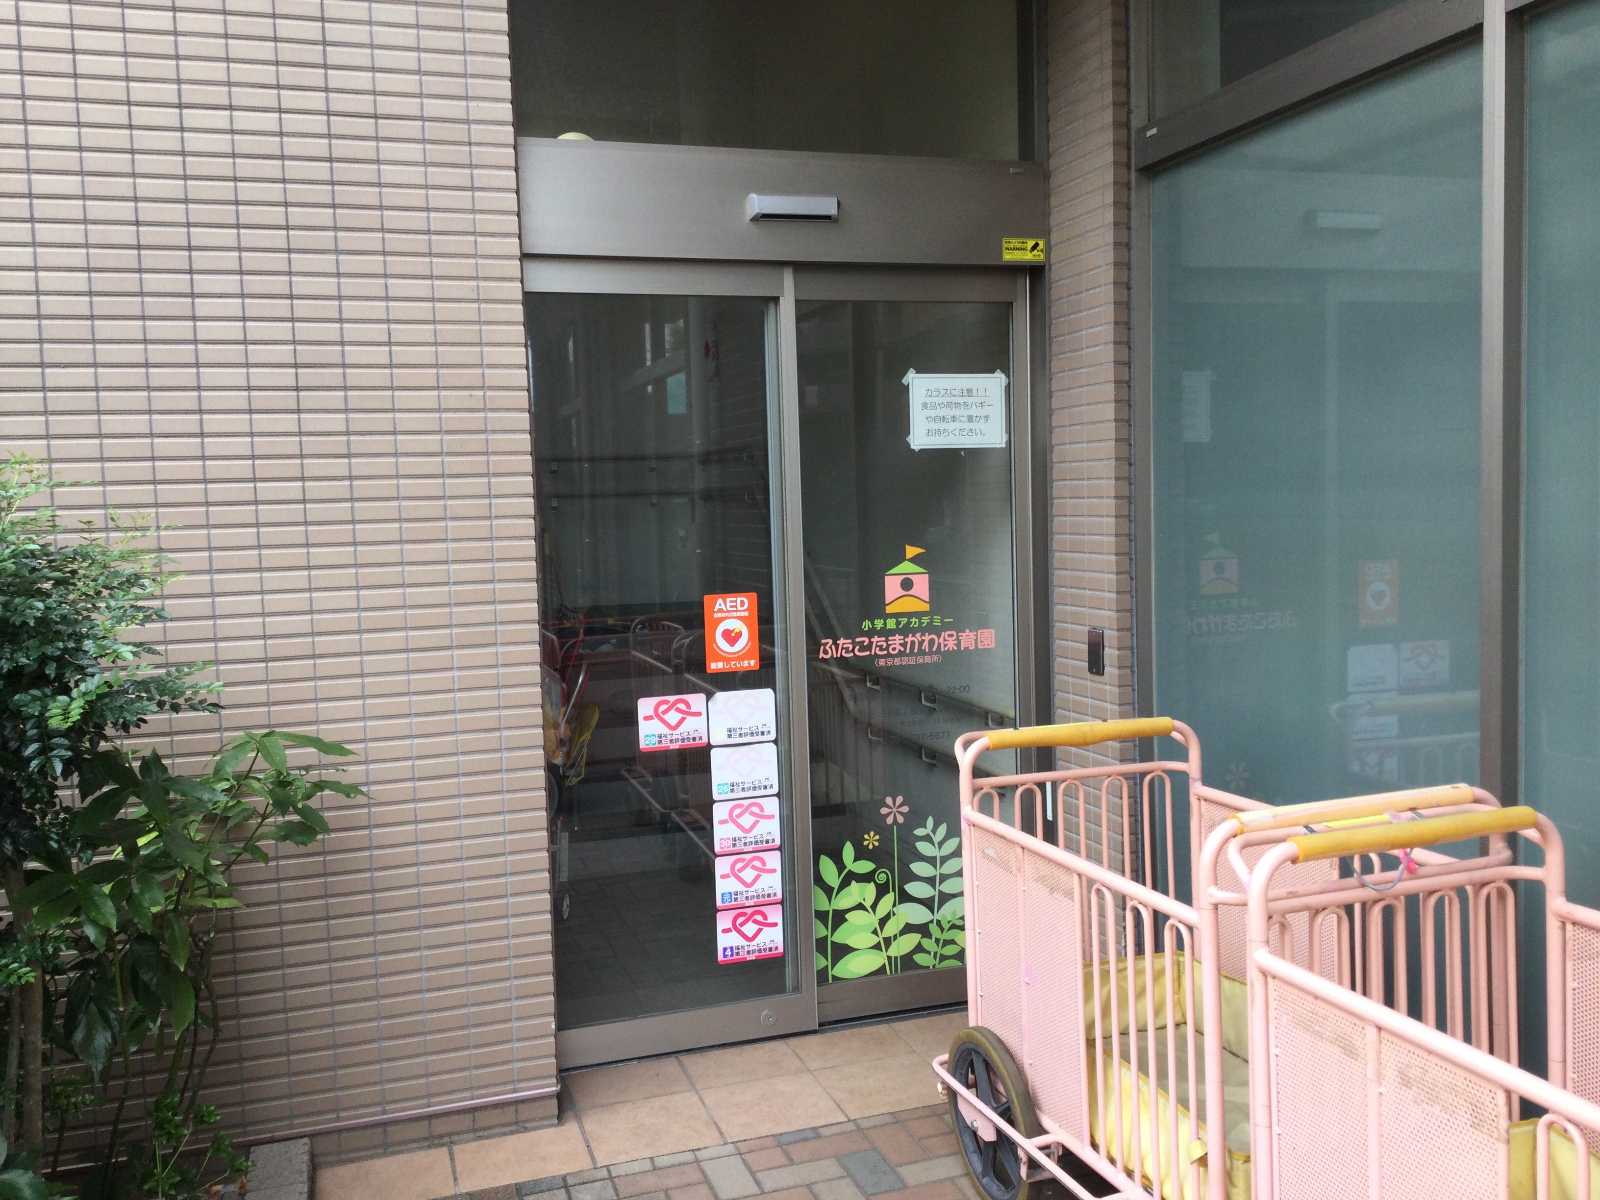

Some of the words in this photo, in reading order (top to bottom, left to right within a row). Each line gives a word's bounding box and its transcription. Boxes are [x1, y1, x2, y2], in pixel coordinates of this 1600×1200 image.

[713, 597, 749, 611] AED
[861, 615, 954, 631] 小学館アカデミー
[818, 628, 996, 660] ふたこたまがわ保育園
